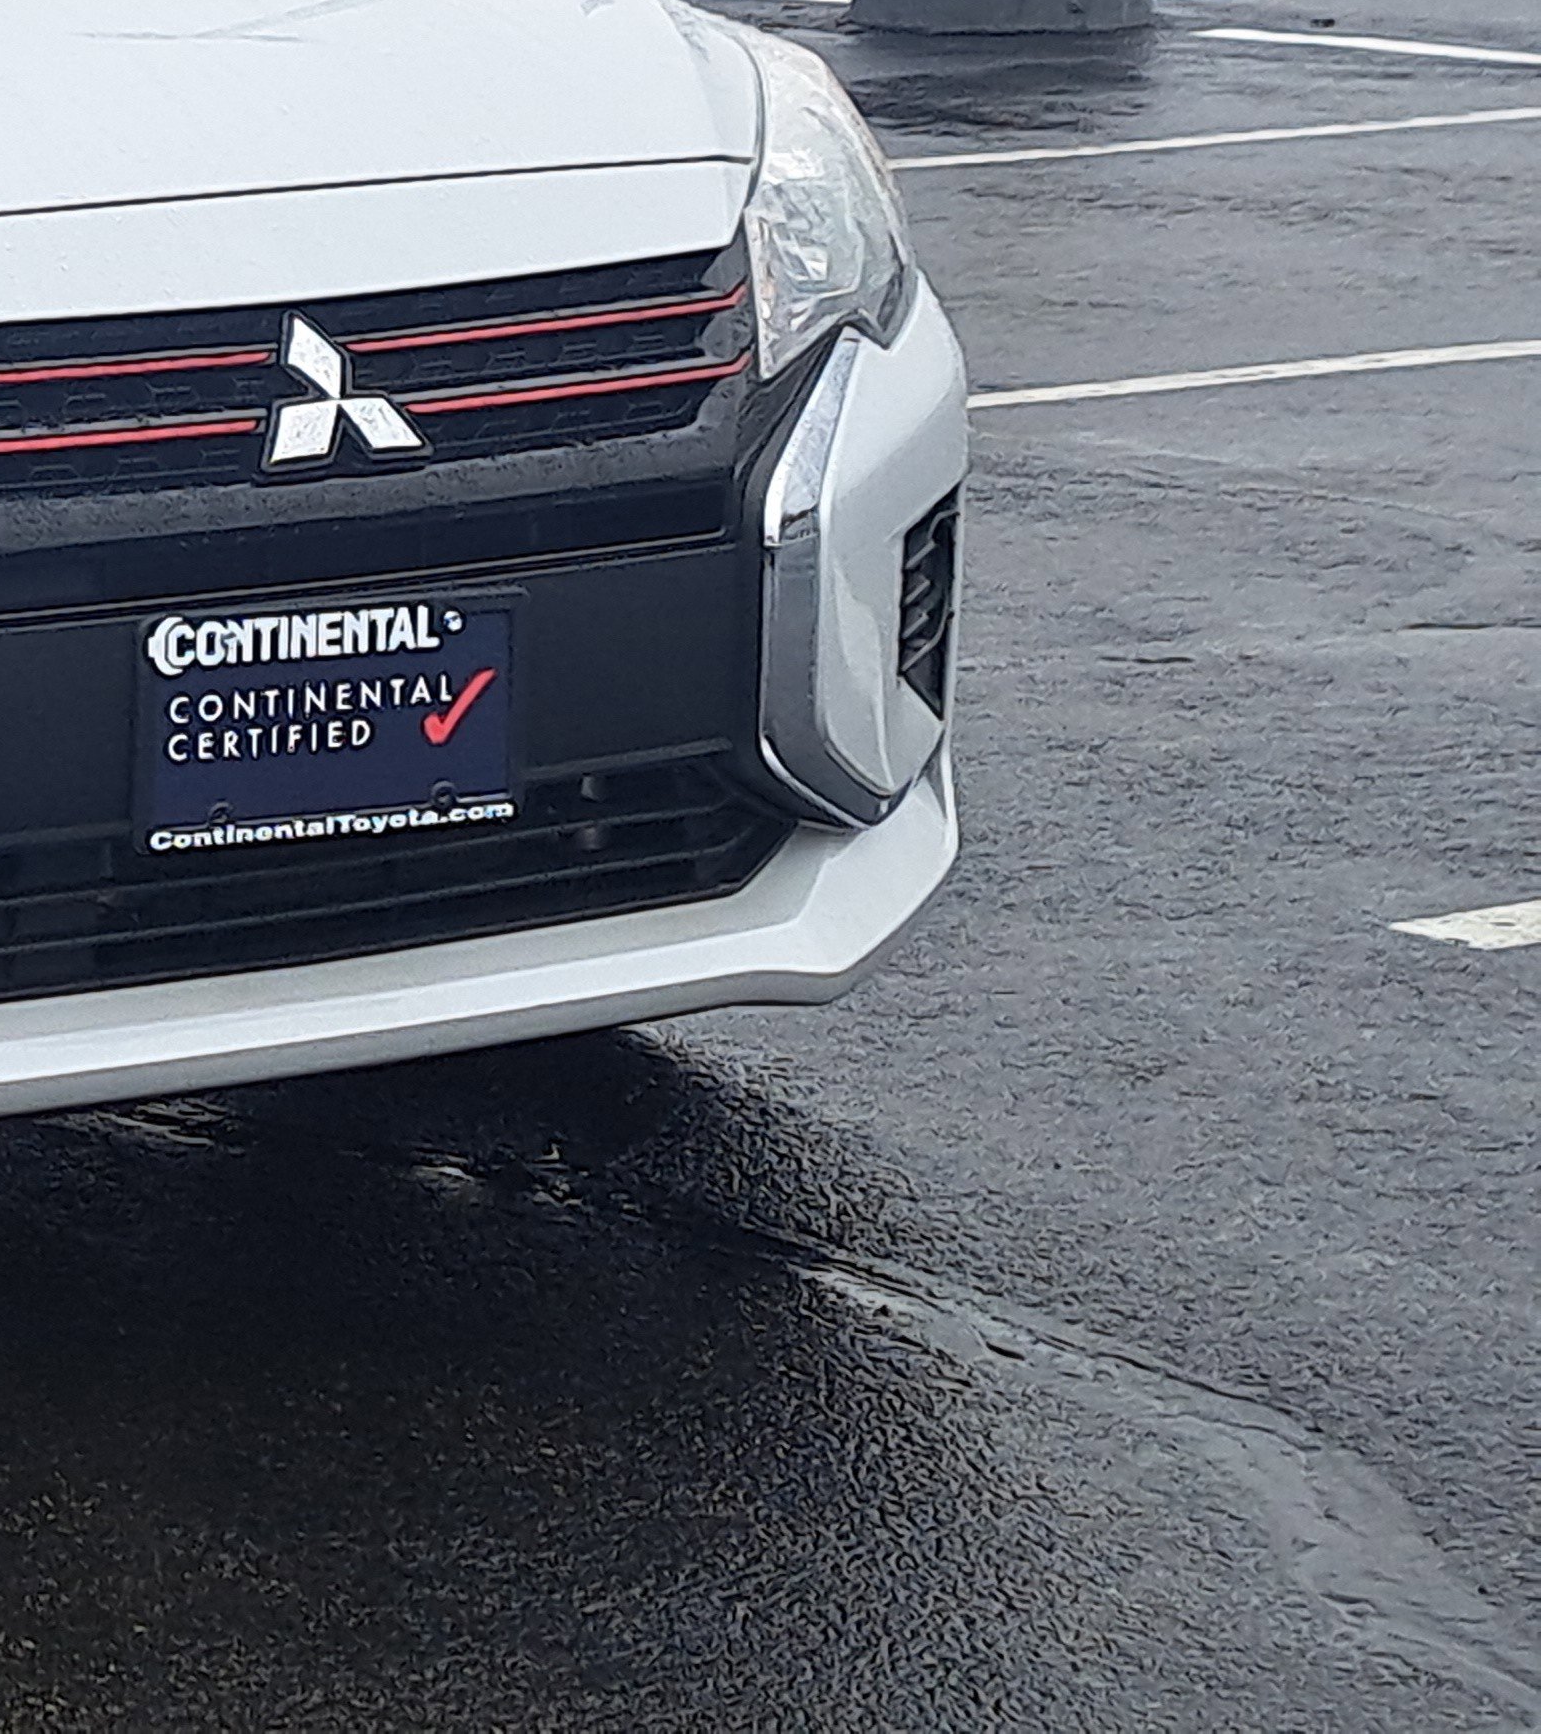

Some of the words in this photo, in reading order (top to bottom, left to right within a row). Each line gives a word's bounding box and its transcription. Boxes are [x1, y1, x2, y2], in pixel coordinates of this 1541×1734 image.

[148, 605, 440, 676] CONTINENTAL
[170, 674, 452, 724] CONTINENTAL
[168, 720, 371, 762] CERTIFIED
[150, 803, 514, 851] ContinentalToyota.com
